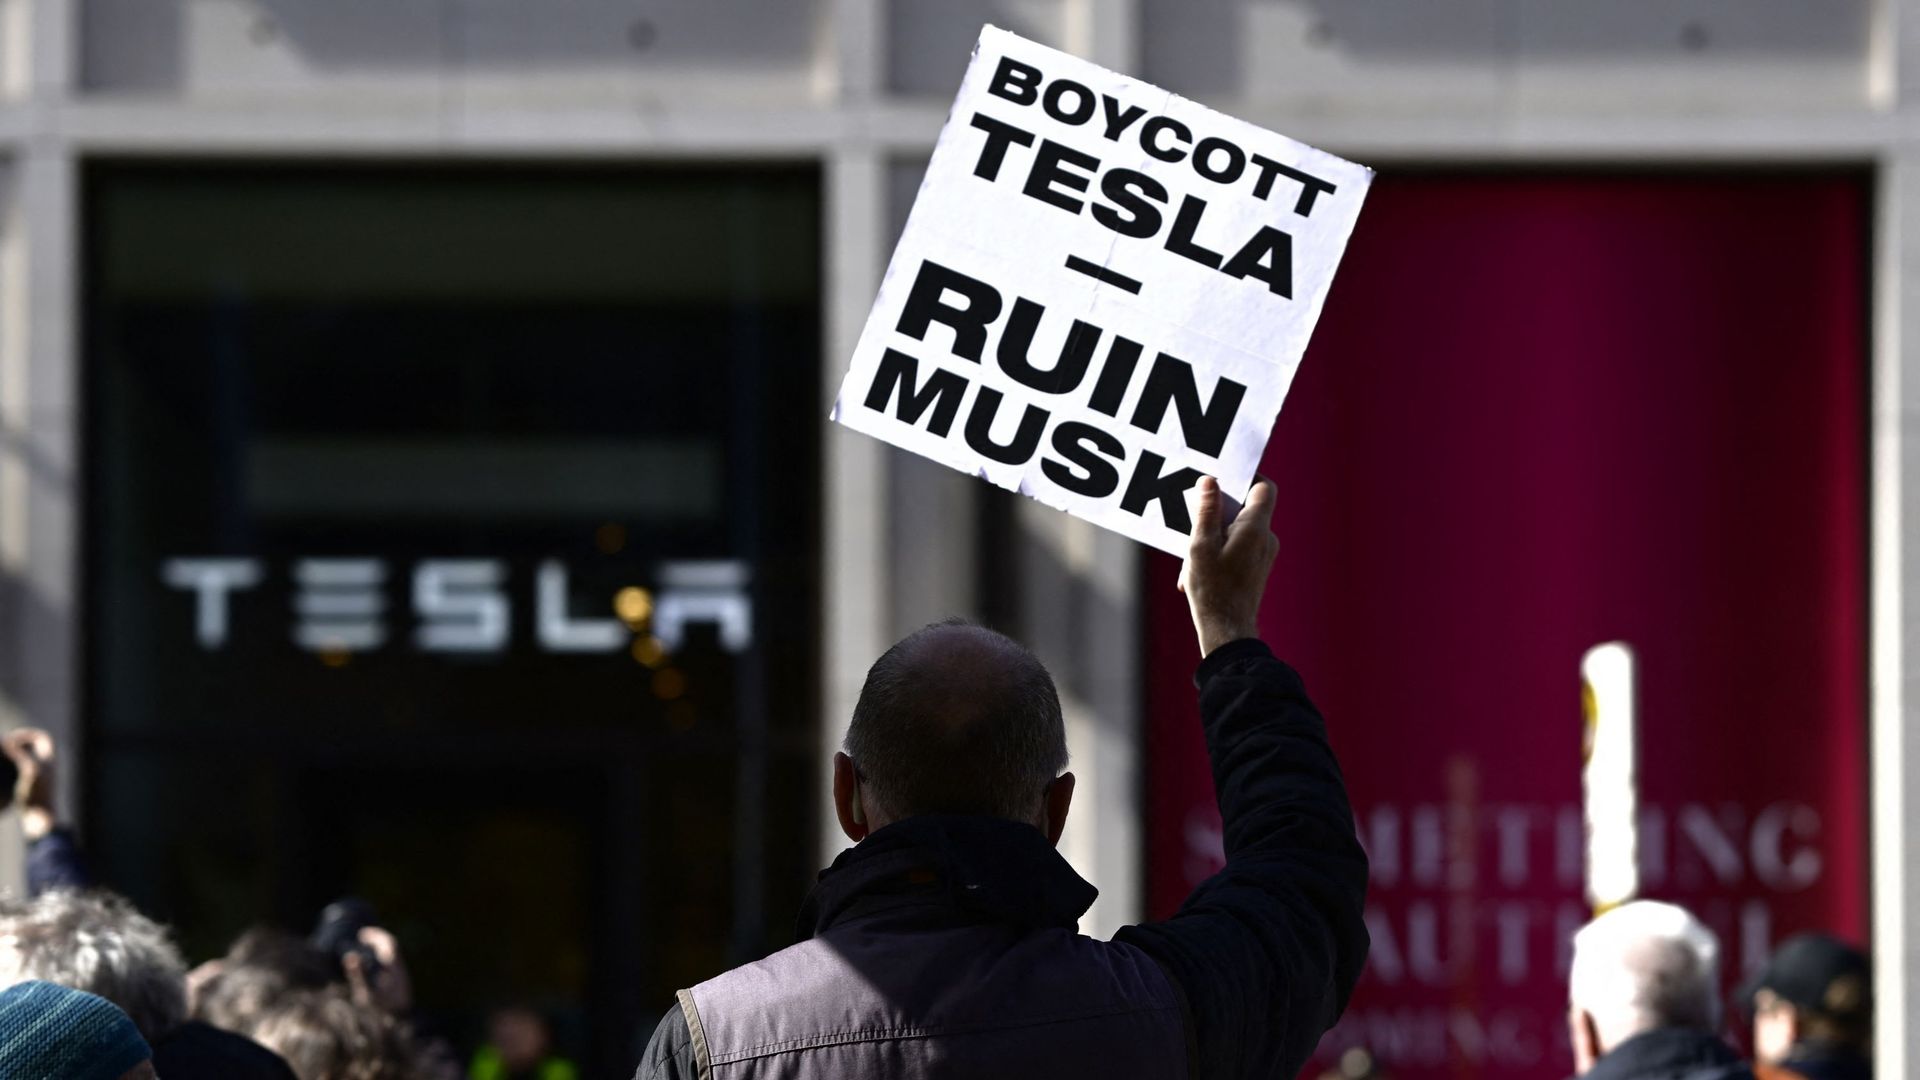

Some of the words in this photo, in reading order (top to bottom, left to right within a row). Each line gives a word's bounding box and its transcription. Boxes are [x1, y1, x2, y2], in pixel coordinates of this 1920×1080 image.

[971, 113, 1292, 300] TESLA
[988, 56, 1336, 217] BOYCOTT
[864, 348, 1212, 536] MUSK
[896, 260, 1247, 459] RUIN
[164, 557, 750, 651] TESLA
